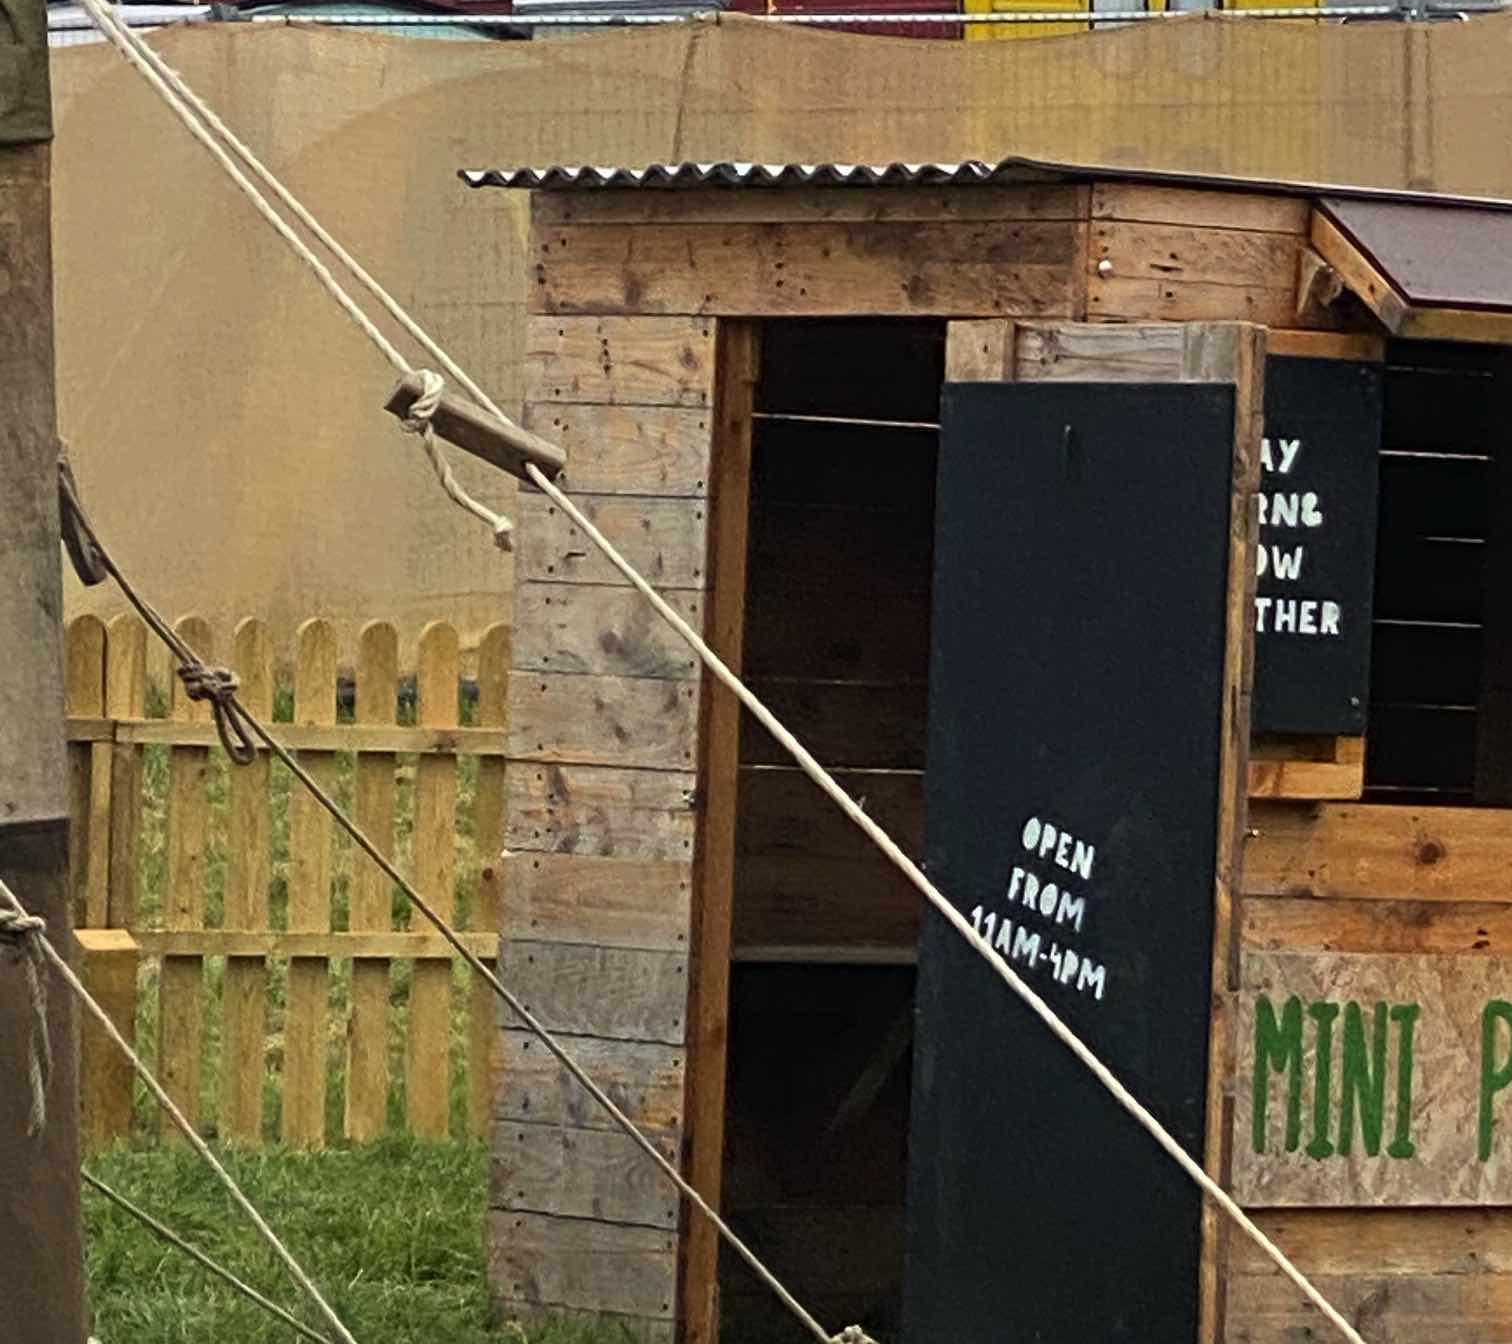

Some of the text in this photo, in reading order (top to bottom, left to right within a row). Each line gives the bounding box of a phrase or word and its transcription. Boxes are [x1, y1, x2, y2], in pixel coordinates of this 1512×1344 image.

[1022, 817, 1095, 880] OPEN
[1007, 867, 1086, 933] FROM
[1251, 994, 1419, 1160] MINI
